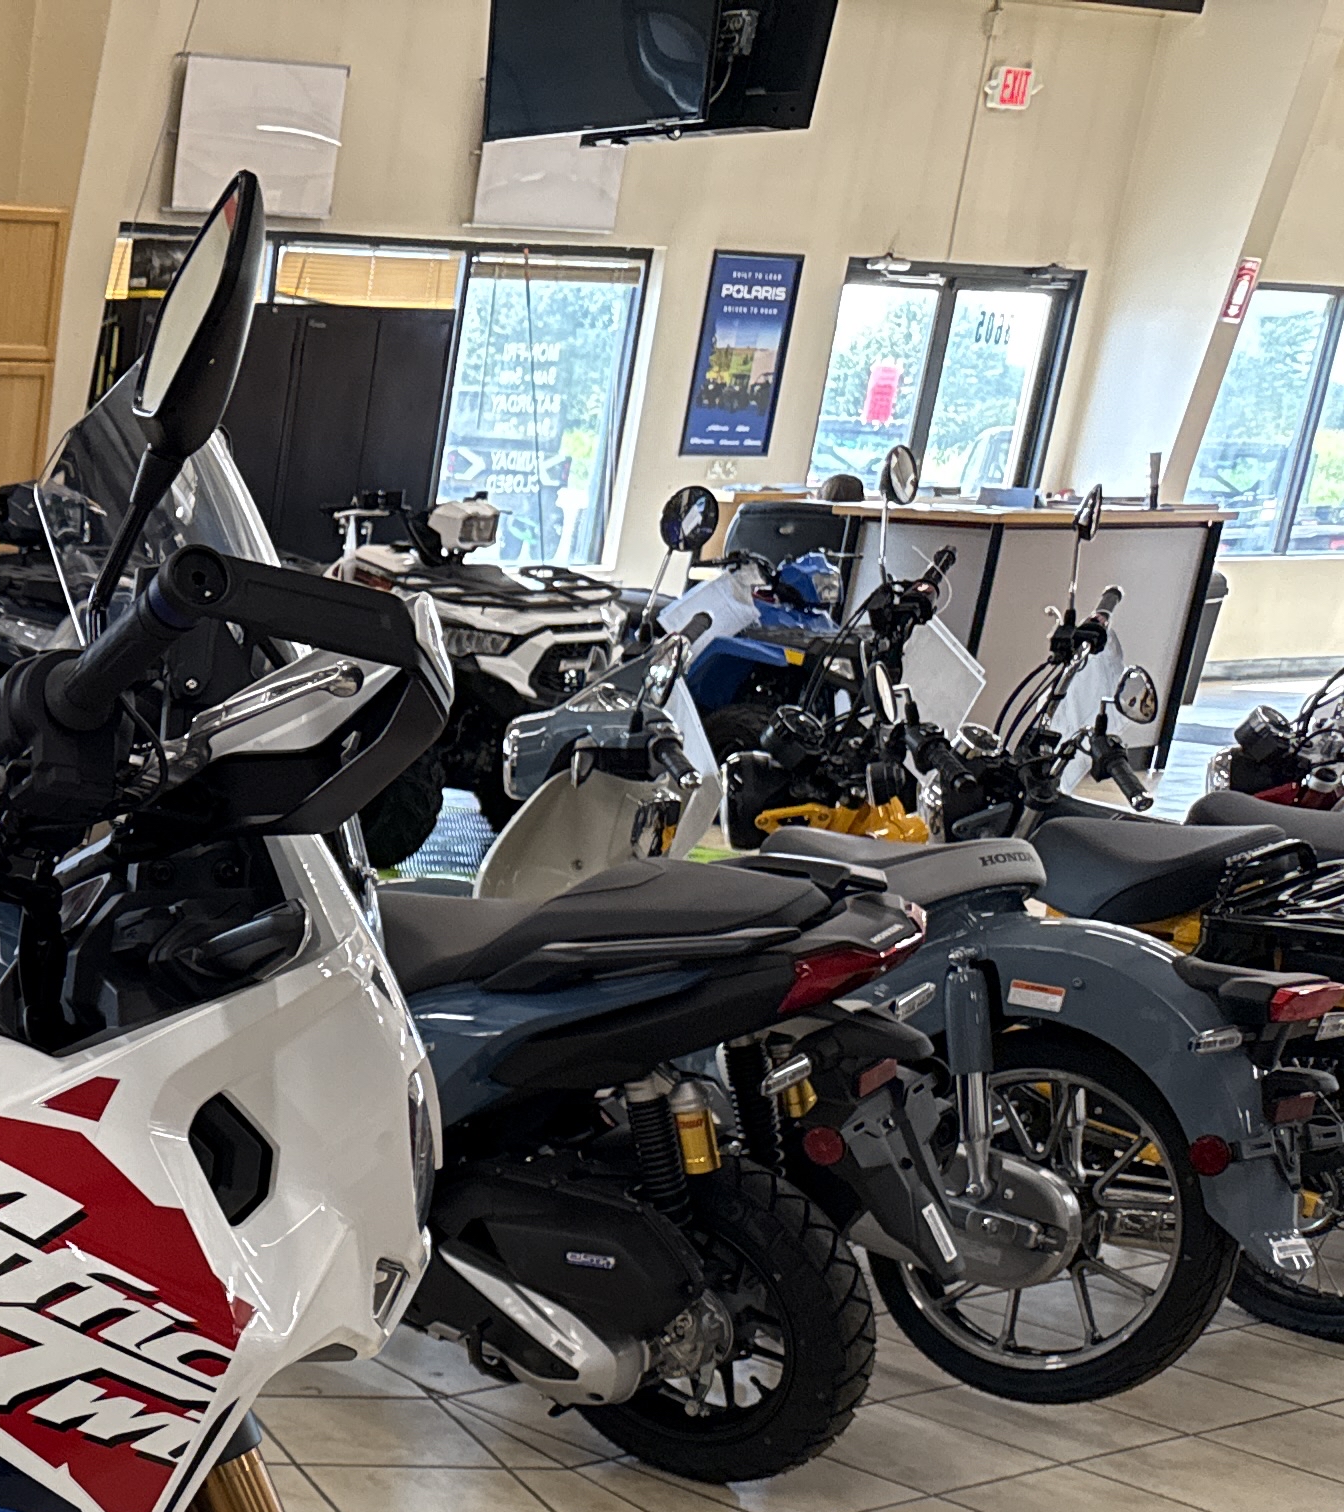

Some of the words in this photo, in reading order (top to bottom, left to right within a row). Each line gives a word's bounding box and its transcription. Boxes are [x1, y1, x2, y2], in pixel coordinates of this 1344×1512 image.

[1000, 70, 1031, 104] EXIT
[721, 283, 787, 301] POLARIS
[980, 851, 1034, 867] HONDA
[870, 923, 905, 944] HONDA
